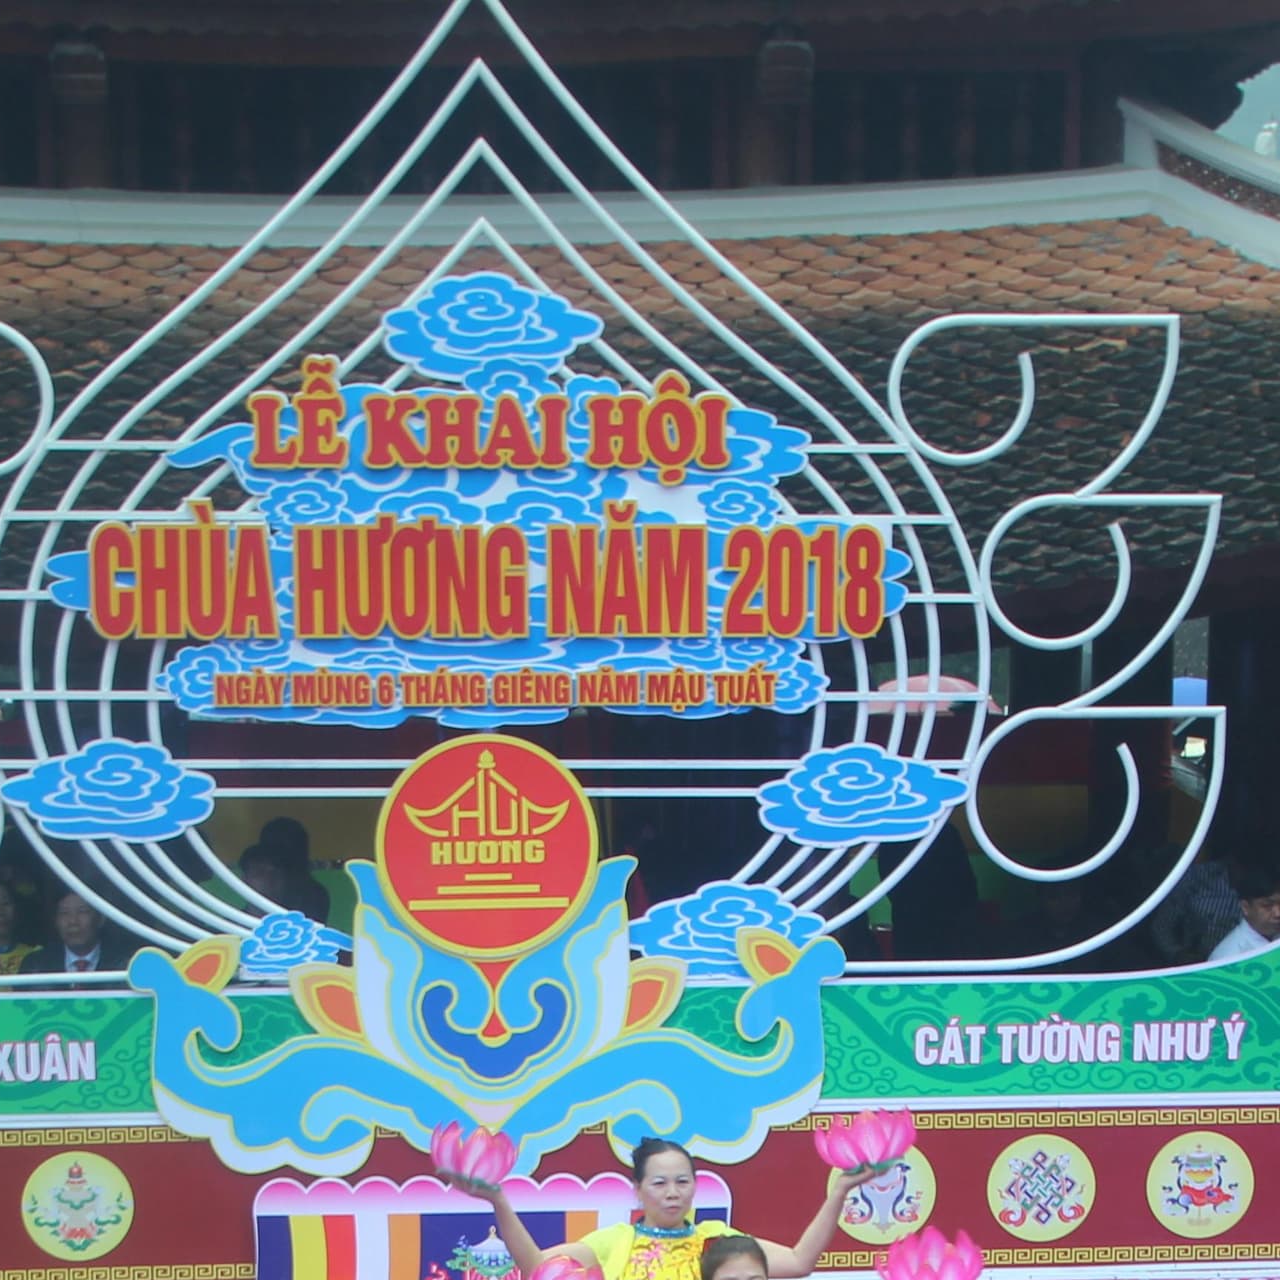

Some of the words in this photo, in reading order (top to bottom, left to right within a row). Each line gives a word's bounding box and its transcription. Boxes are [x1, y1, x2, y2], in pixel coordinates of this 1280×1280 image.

[249, 357, 347, 467] LỄ
[365, 395, 570, 467] KHAI
[588, 371, 730, 484] HỘI
[91, 499, 280, 638] CHÙA
[295, 514, 530, 638] HƯƠNG
[547, 501, 707, 637] NĂM
[723, 525, 885, 638] 2018
[215, 667, 286, 706] NGÀY
[292, 666, 372, 706] MÙNG
[377, 674, 395, 706] 6
[400, 666, 487, 706] THÁNG
[493, 667, 570, 705] GIÊNG
[577, 665, 640, 706] NĂM
[646, 667, 706, 712] MẬU
[714, 662, 777, 706] TUẤT
[914, 1017, 986, 1065] CÁT
[996, 1013, 1120, 1065] TƯỜNG
[1132, 1018, 1216, 1062] NHƯ
[1223, 1012, 1245, 1060] Ý
